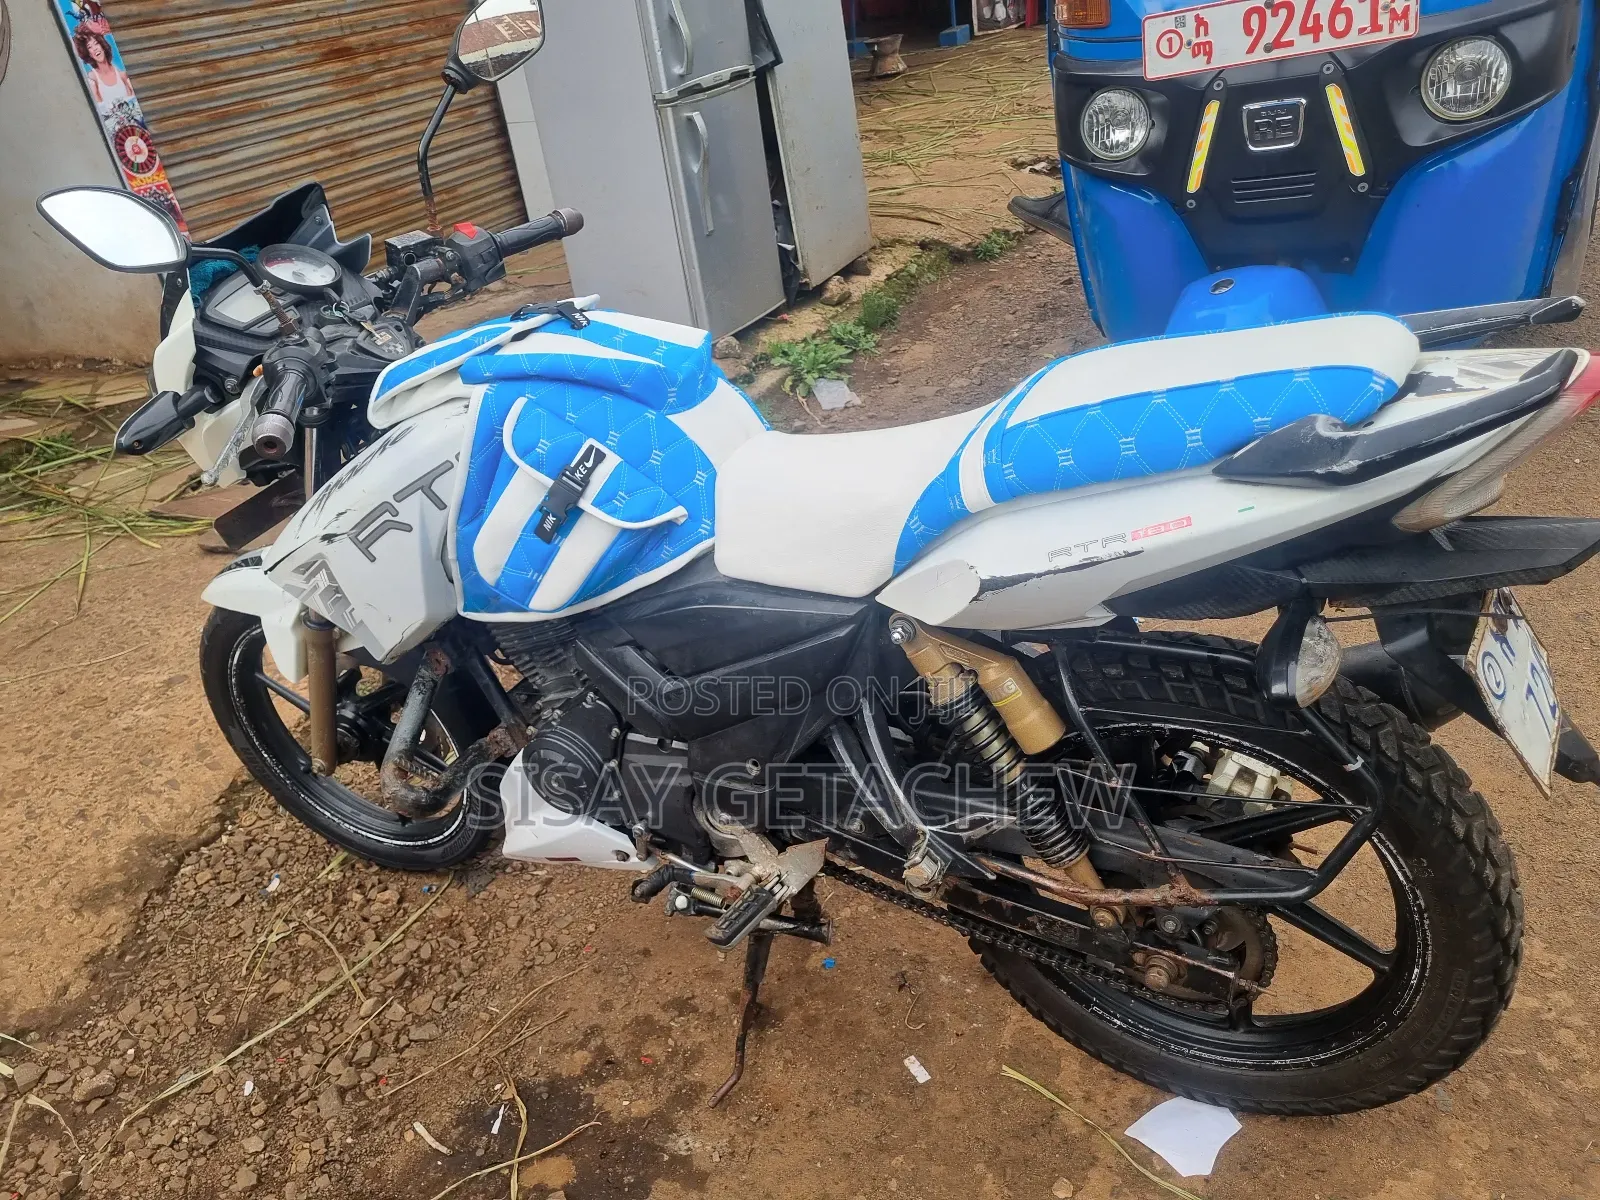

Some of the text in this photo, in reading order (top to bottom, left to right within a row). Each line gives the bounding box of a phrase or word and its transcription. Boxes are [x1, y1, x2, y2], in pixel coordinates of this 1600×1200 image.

[1242, 0, 1383, 55] 92461
[1389, 4, 1410, 34] M
[1254, 116, 1293, 141] RE
[346, 450, 461, 563] RT
[1048, 533, 1127, 562] RTR
